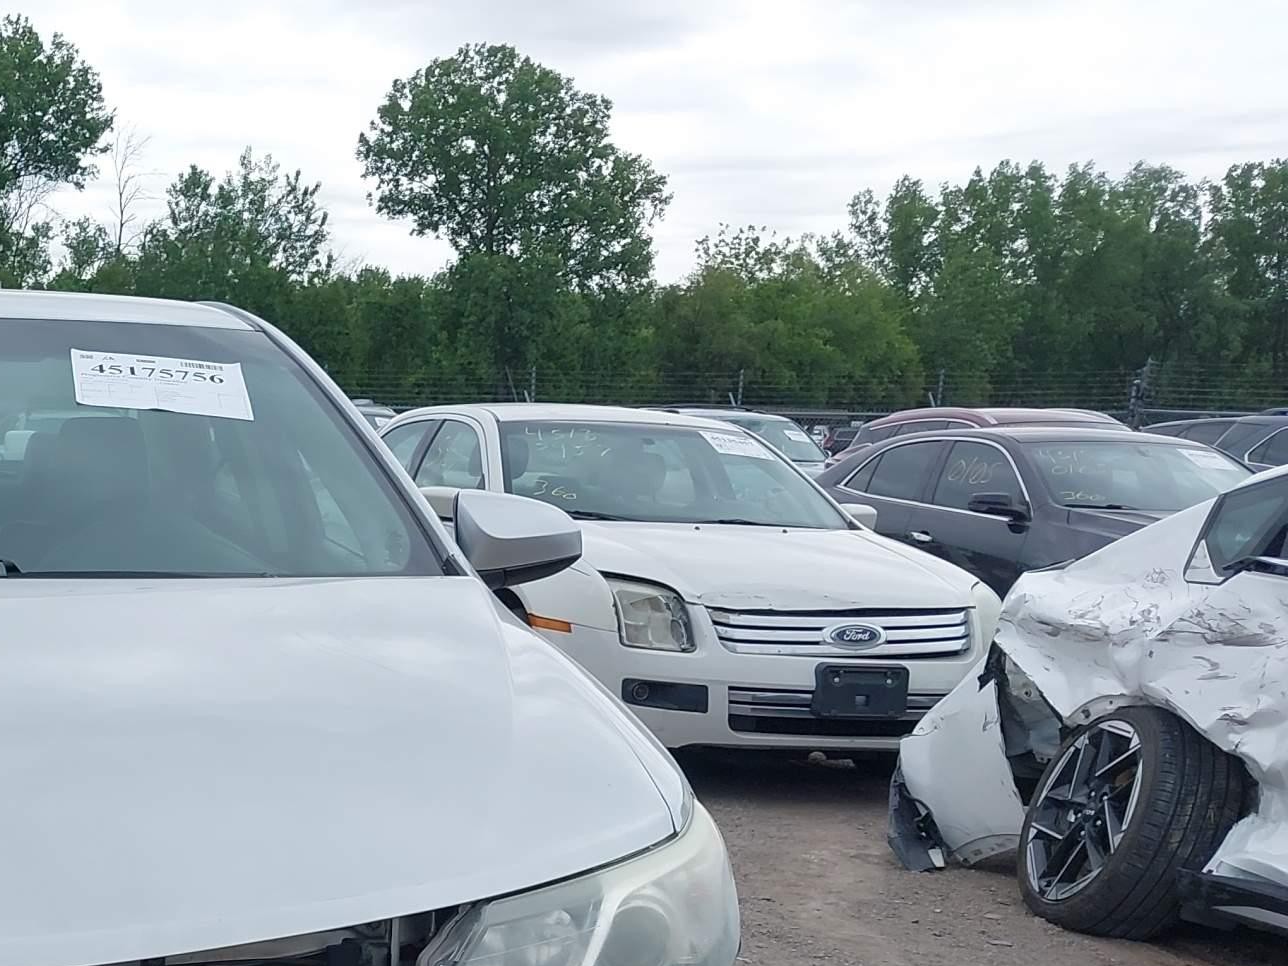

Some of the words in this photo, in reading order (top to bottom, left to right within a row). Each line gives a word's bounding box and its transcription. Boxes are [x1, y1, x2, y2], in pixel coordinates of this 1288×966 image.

[90, 363, 225, 385] 45175756
[533, 479, 578, 500] 360
[843, 629, 871, 641] Ford
